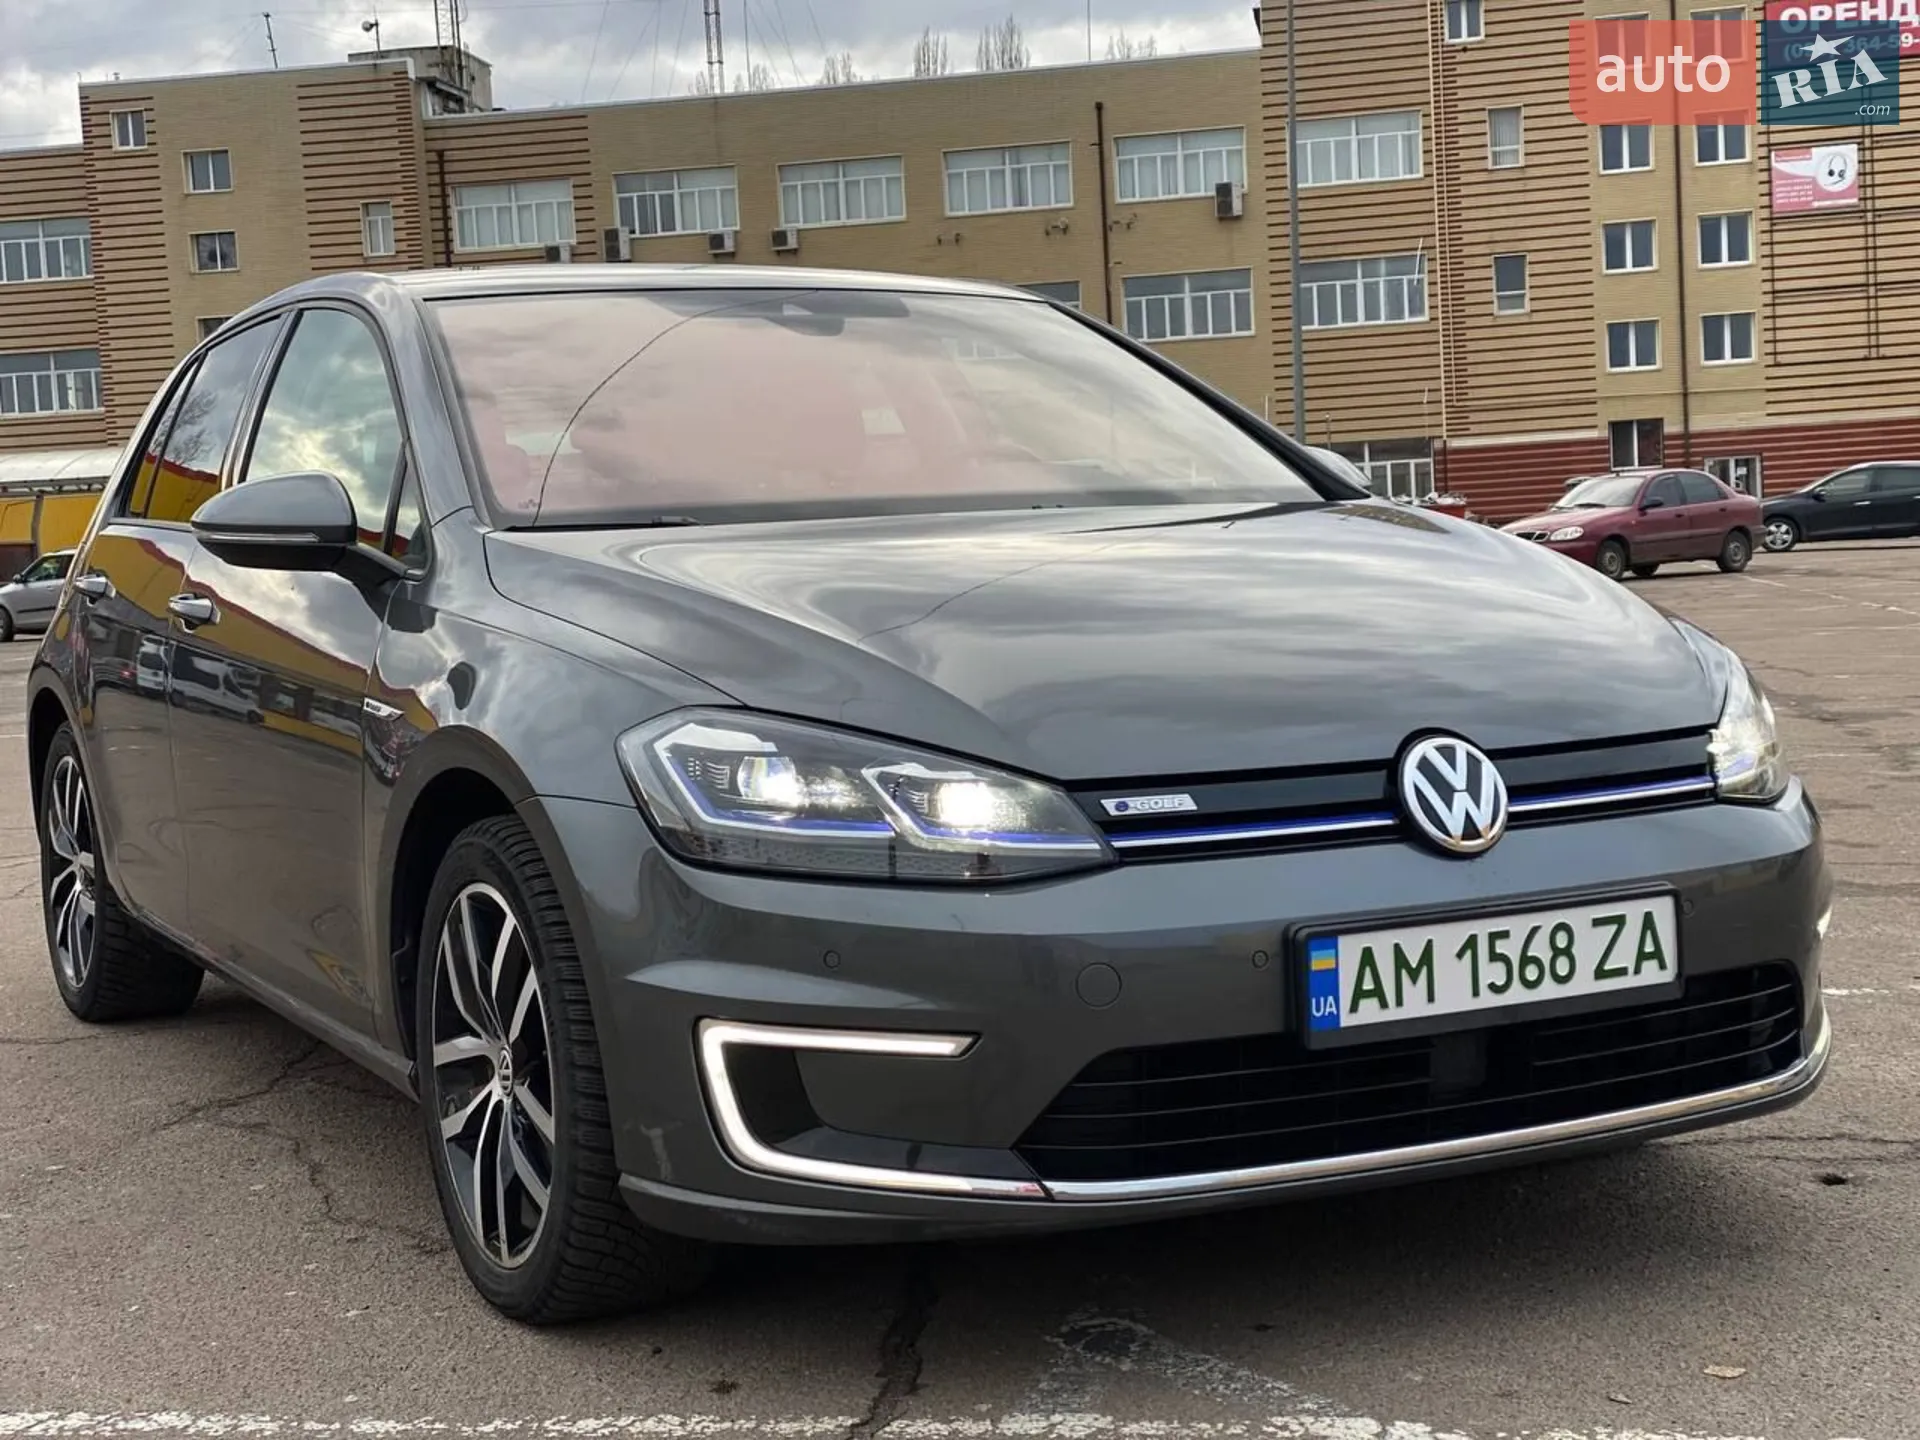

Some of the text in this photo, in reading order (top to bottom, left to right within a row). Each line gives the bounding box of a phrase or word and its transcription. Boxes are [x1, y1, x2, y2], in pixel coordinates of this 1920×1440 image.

[1780, 0, 1920, 34] ОРЕНД
[1349, 910, 1669, 1014] AM 1568 ZA
[1311, 995, 1338, 1017] UA
